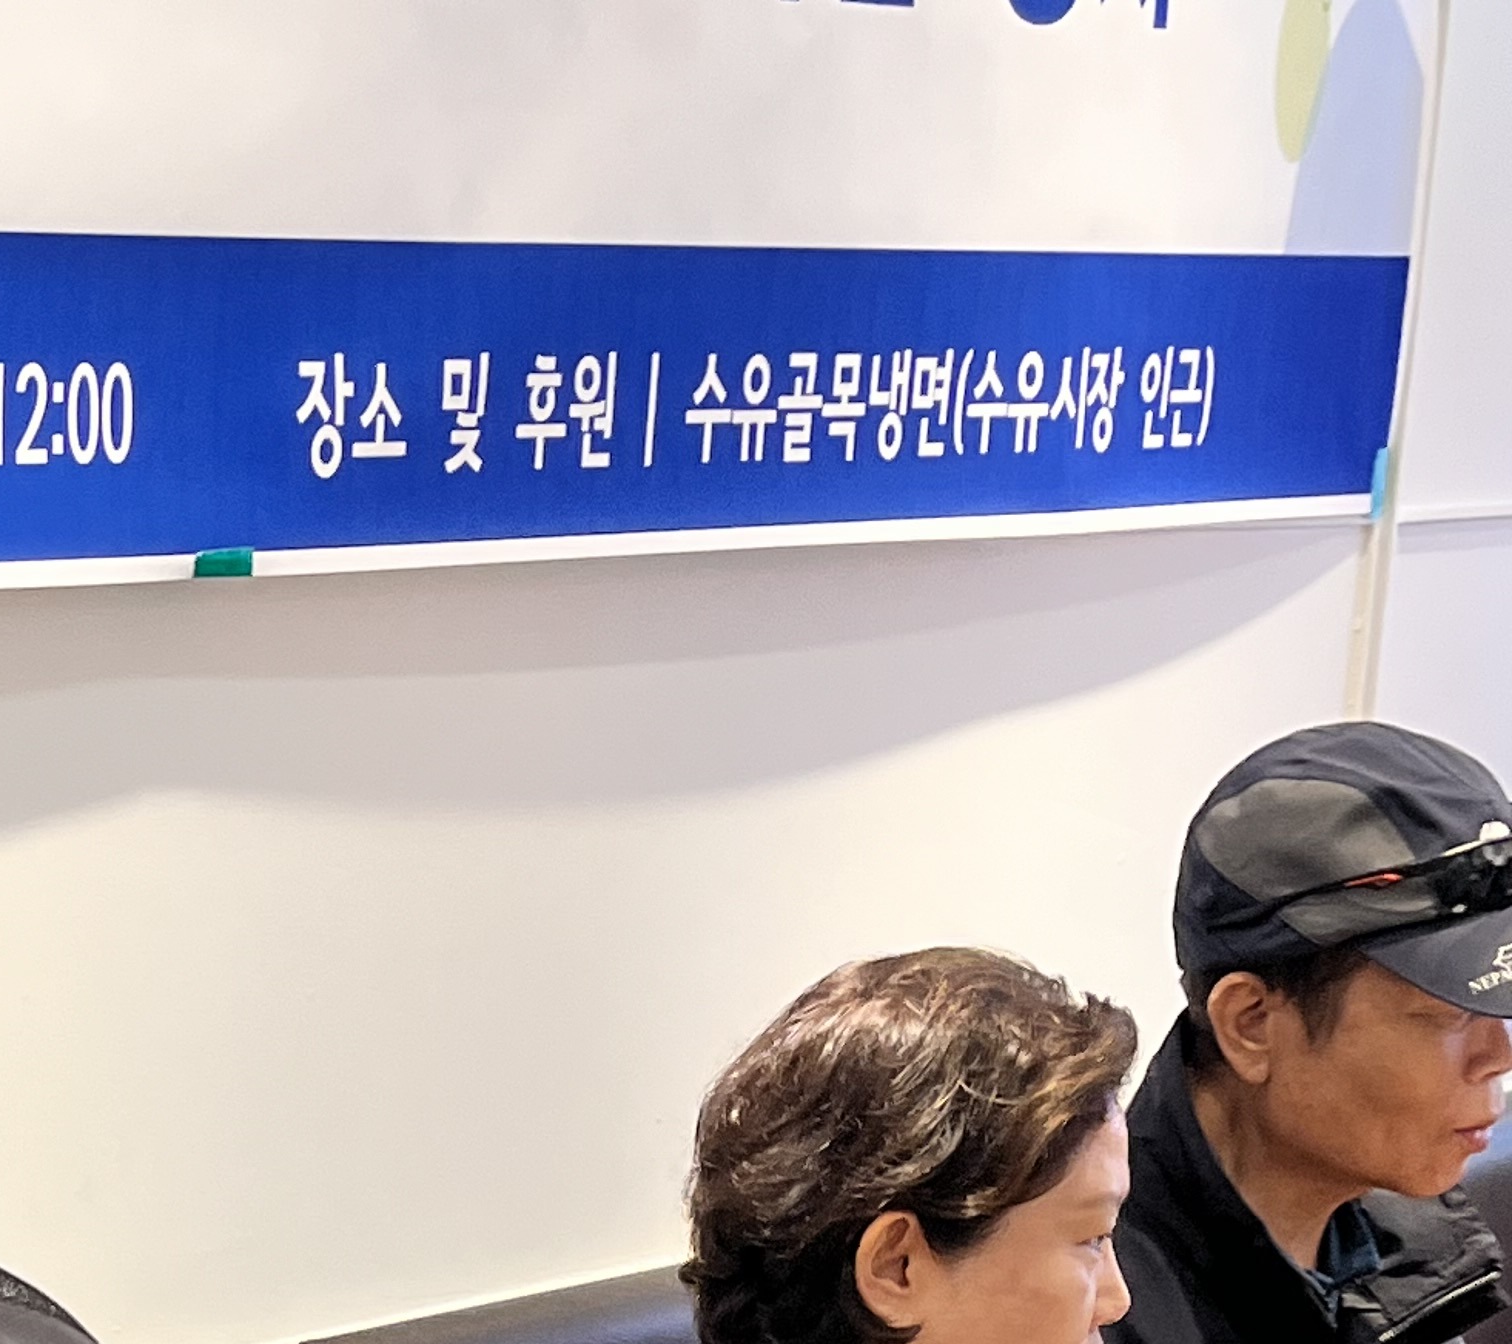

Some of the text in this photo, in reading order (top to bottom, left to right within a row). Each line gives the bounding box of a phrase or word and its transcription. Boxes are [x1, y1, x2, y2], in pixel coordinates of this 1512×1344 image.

[294, 351, 408, 480] 장소
[440, 350, 491, 475] 및
[514, 350, 618, 471] 후원
[684, 345, 1127, 465] 수유골목냉면(수유시장
[1139, 344, 1216, 450] 인근)
